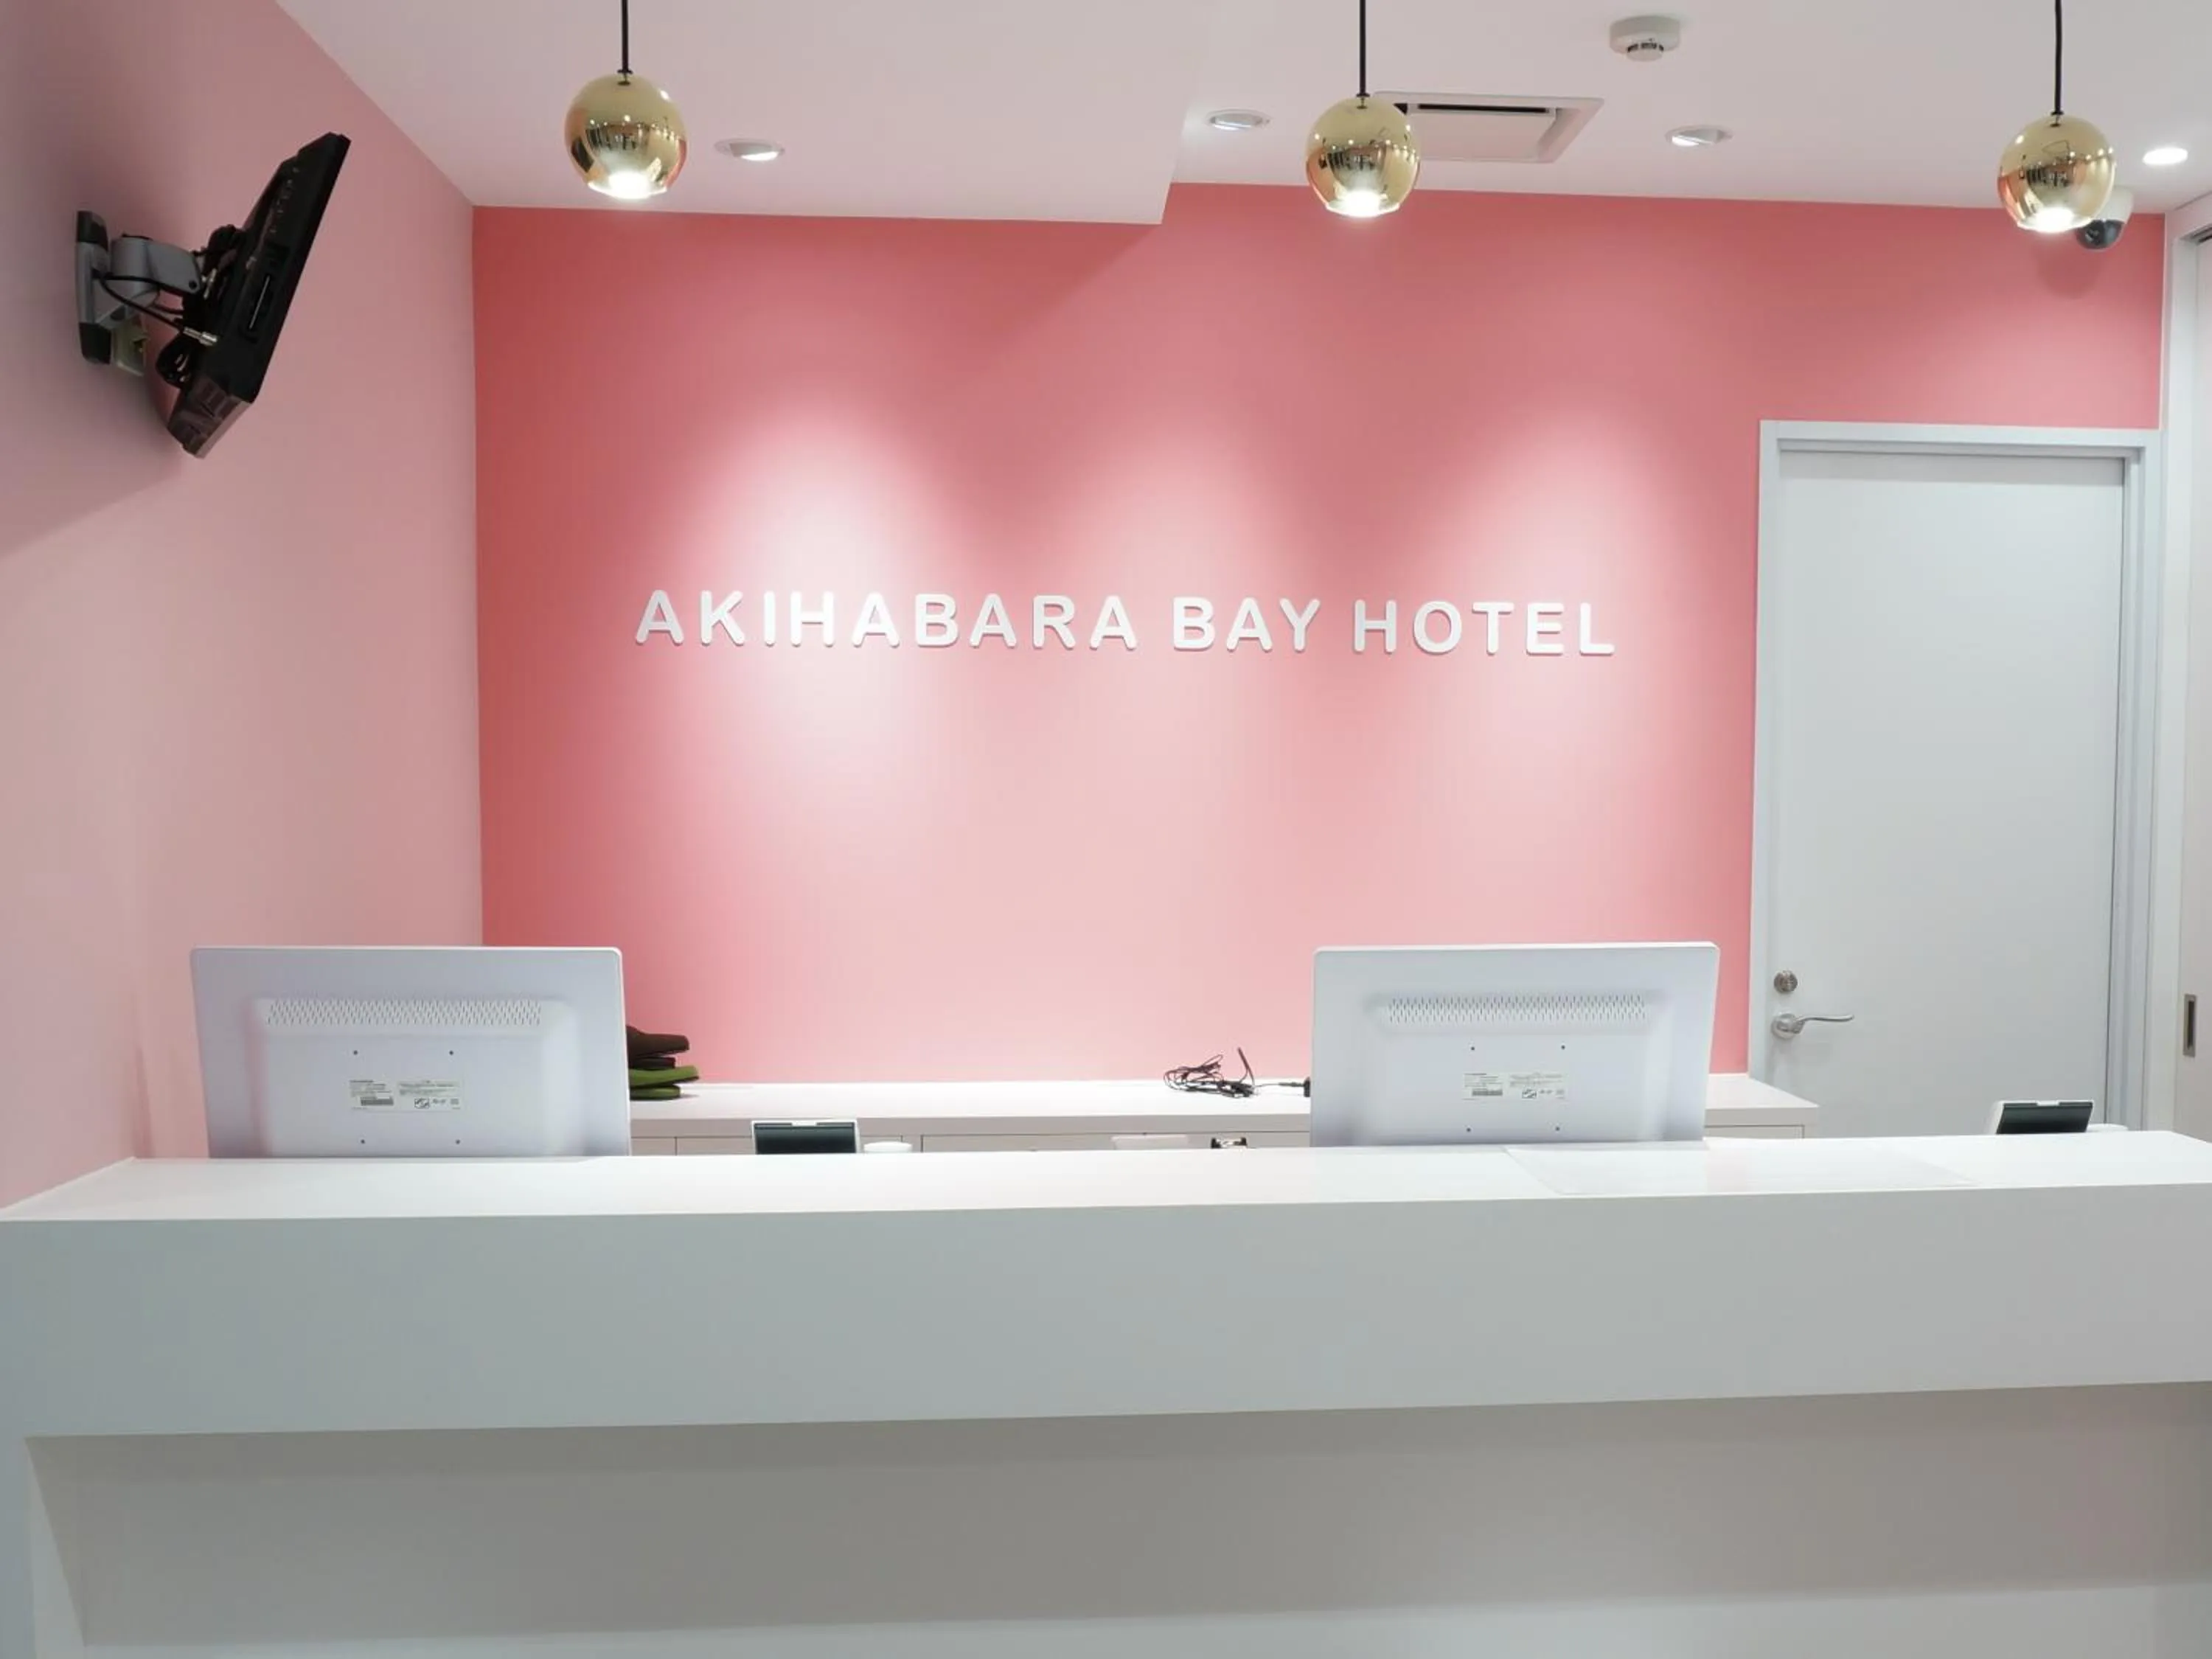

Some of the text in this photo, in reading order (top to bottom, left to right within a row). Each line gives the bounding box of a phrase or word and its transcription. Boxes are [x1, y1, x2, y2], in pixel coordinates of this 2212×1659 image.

[635, 590, 1615, 655] AKIHABARA BAY HOTEL
